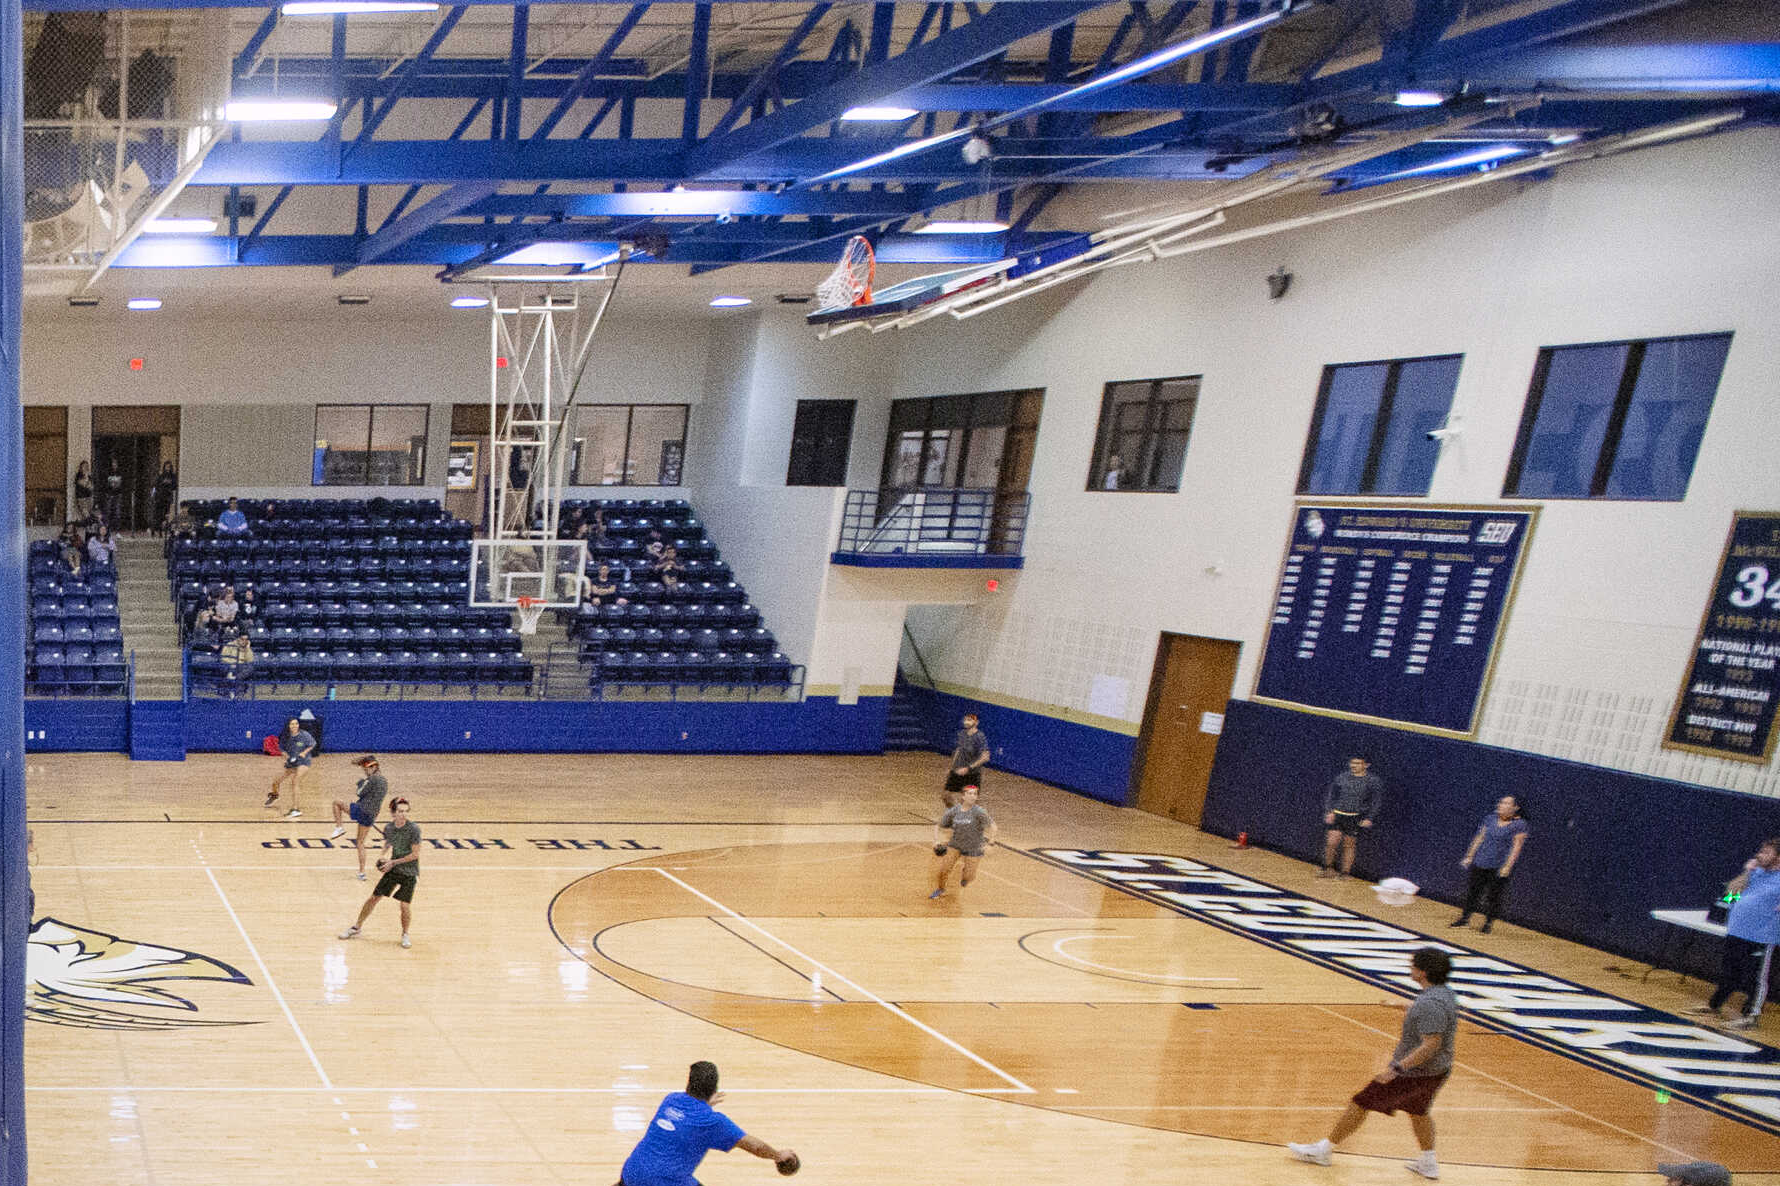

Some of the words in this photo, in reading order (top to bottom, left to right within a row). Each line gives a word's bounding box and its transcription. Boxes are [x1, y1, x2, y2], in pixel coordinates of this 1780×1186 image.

[1475, 520, 1517, 544] SEU
[261, 837, 515, 850] HILTOP
[526, 838, 663, 850] THE
